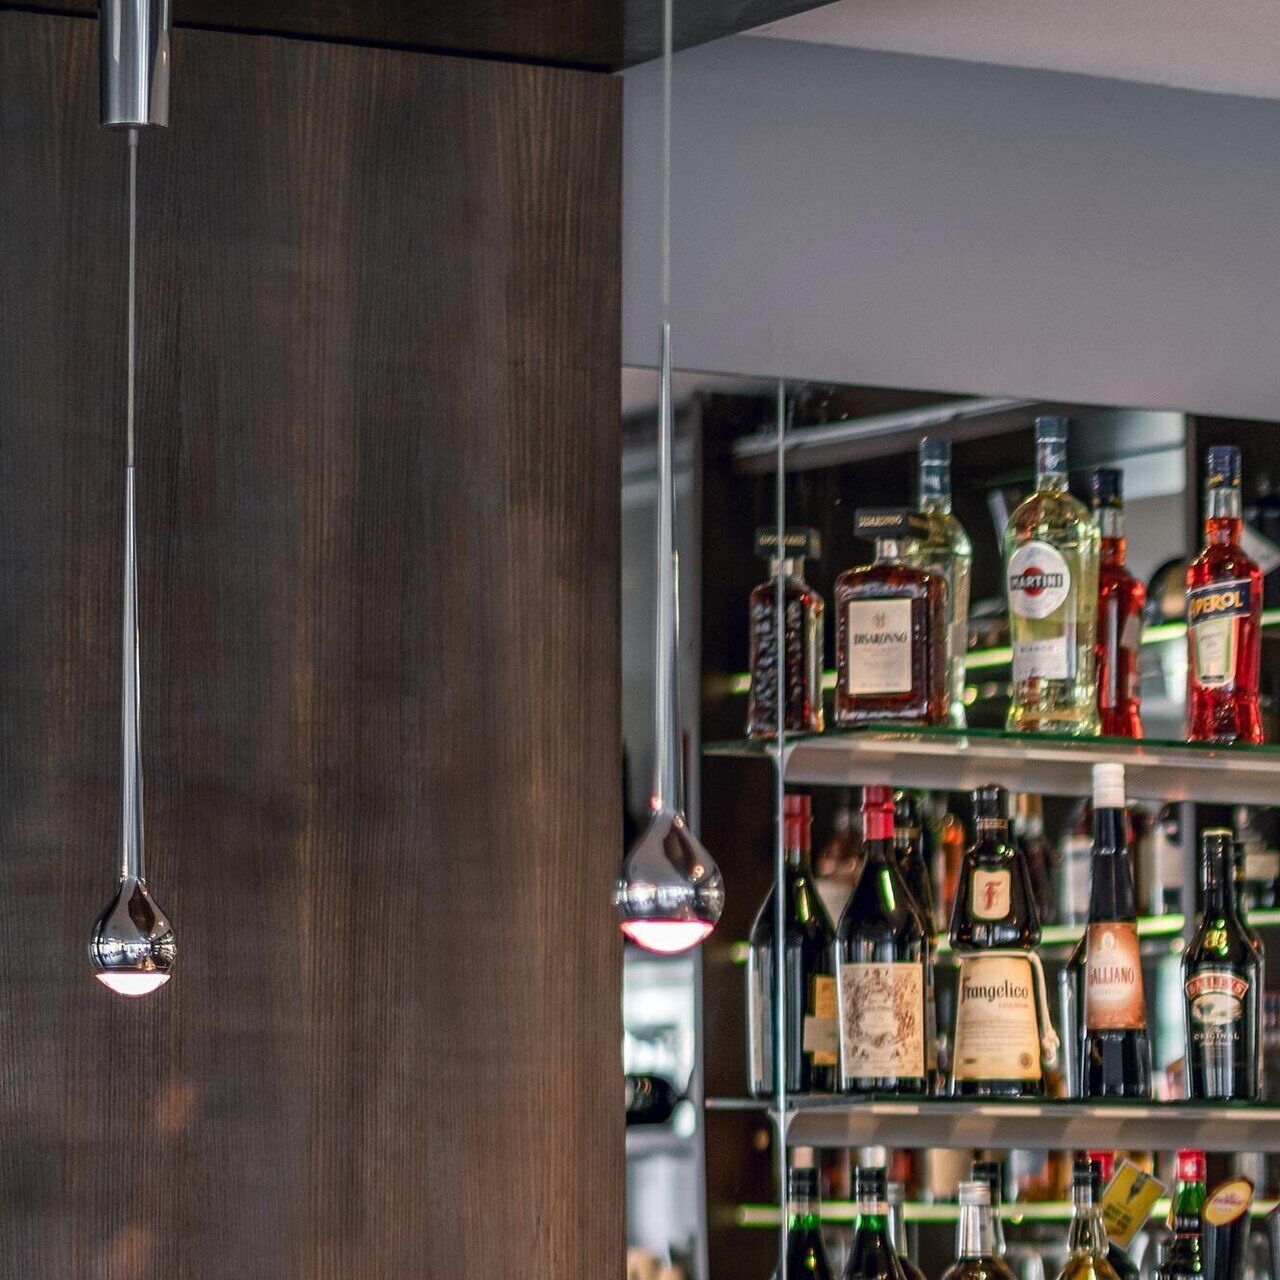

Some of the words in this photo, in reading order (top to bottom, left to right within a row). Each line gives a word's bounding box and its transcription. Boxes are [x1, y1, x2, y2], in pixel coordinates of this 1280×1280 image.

[1010, 573, 1064, 590] MARTINI
[853, 633, 908, 646] DISARONNO
[960, 976, 1029, 1003] Frangelico
[1187, 974, 1247, 995] BAILEYS
